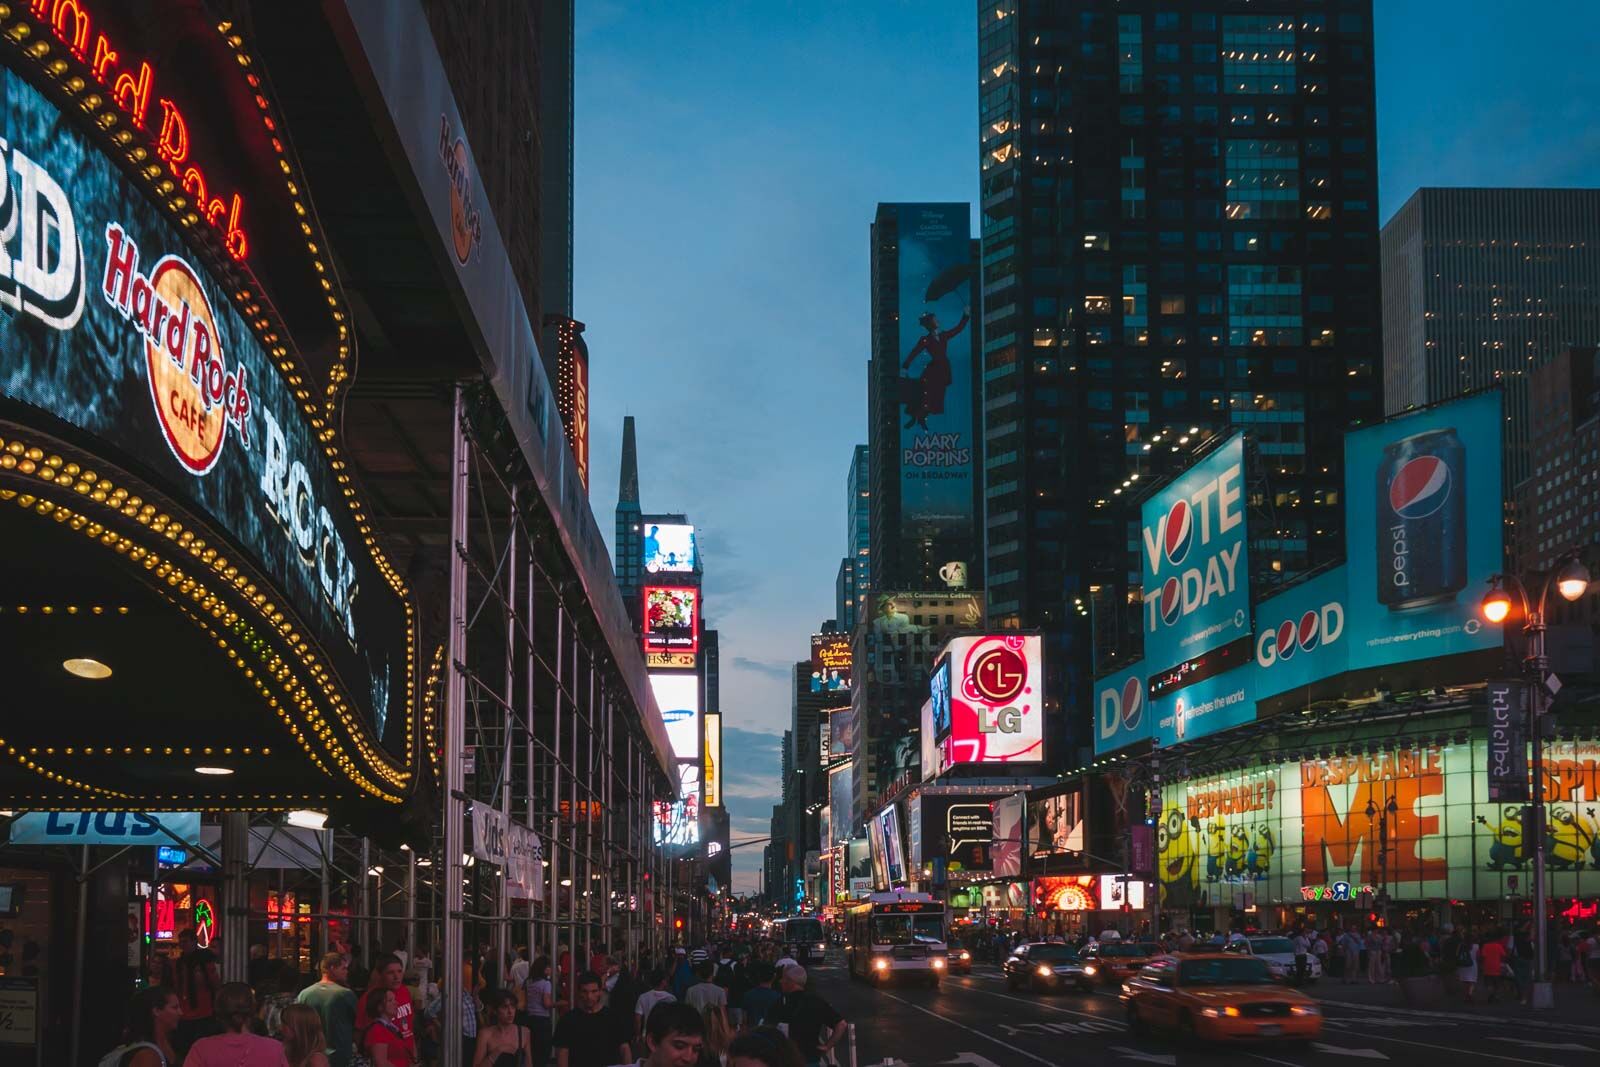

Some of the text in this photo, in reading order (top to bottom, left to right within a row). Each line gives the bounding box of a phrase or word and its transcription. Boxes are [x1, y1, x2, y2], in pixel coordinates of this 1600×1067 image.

[103, 223, 251, 450] Hard Rock
[904, 448, 970, 467] POPPINS
[914, 432, 961, 450] MARY
[1392, 523, 1411, 588] pepsi
[1143, 540, 1242, 632] TODAY
[1257, 601, 1345, 668] GOOD
[977, 707, 1022, 735] LG
[1159, 688, 1245, 729] every refreshes the world
[1302, 744, 1442, 788] DESPICABLE
[1302, 774, 1449, 887] ME
